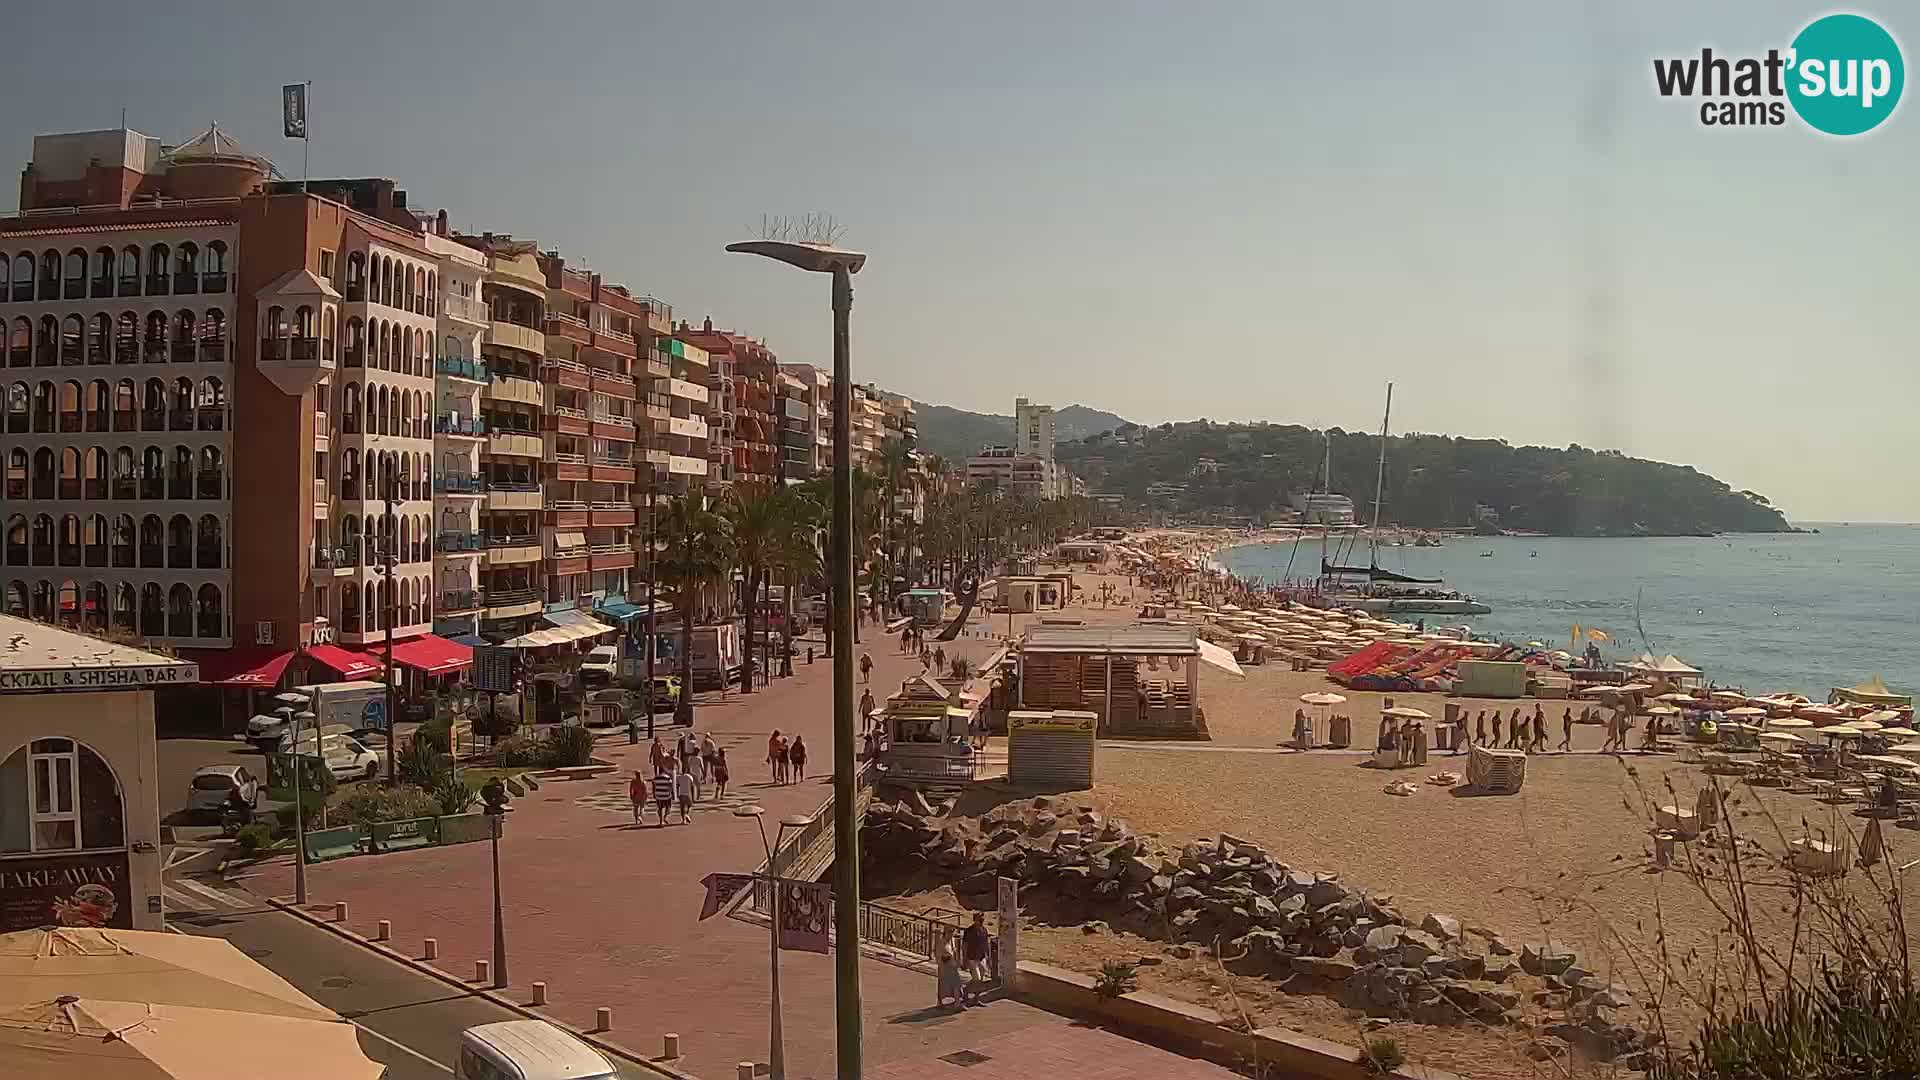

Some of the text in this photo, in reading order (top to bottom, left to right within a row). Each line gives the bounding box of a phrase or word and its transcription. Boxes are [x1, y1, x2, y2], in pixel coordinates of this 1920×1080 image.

[313, 627, 336, 644] KFC
[63, 672, 74, 685] &
[79, 671, 140, 685] SHISHA
[145, 668, 177, 682] BAR
